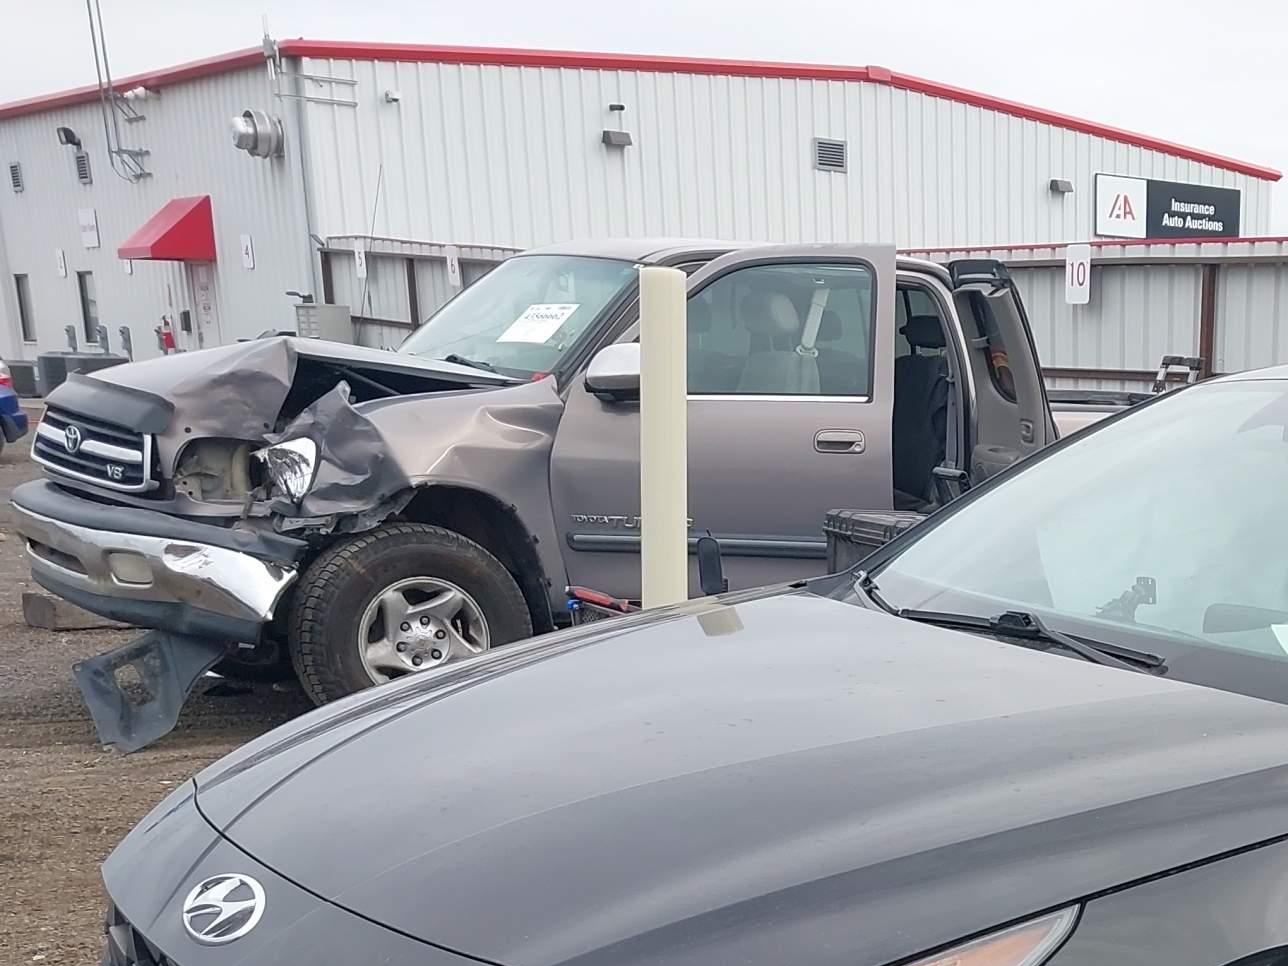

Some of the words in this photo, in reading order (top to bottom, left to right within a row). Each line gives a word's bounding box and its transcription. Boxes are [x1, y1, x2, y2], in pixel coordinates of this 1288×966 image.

[1171, 198, 1215, 215] Insurance
[1162, 213, 1184, 227] Auto
[1185, 216, 1223, 232] Auctions
[243, 244, 250, 259] 4
[357, 251, 363, 267] 5
[450, 258, 456, 275] 6
[1069, 261, 1086, 287] 10
[106, 463, 124, 479] V8
